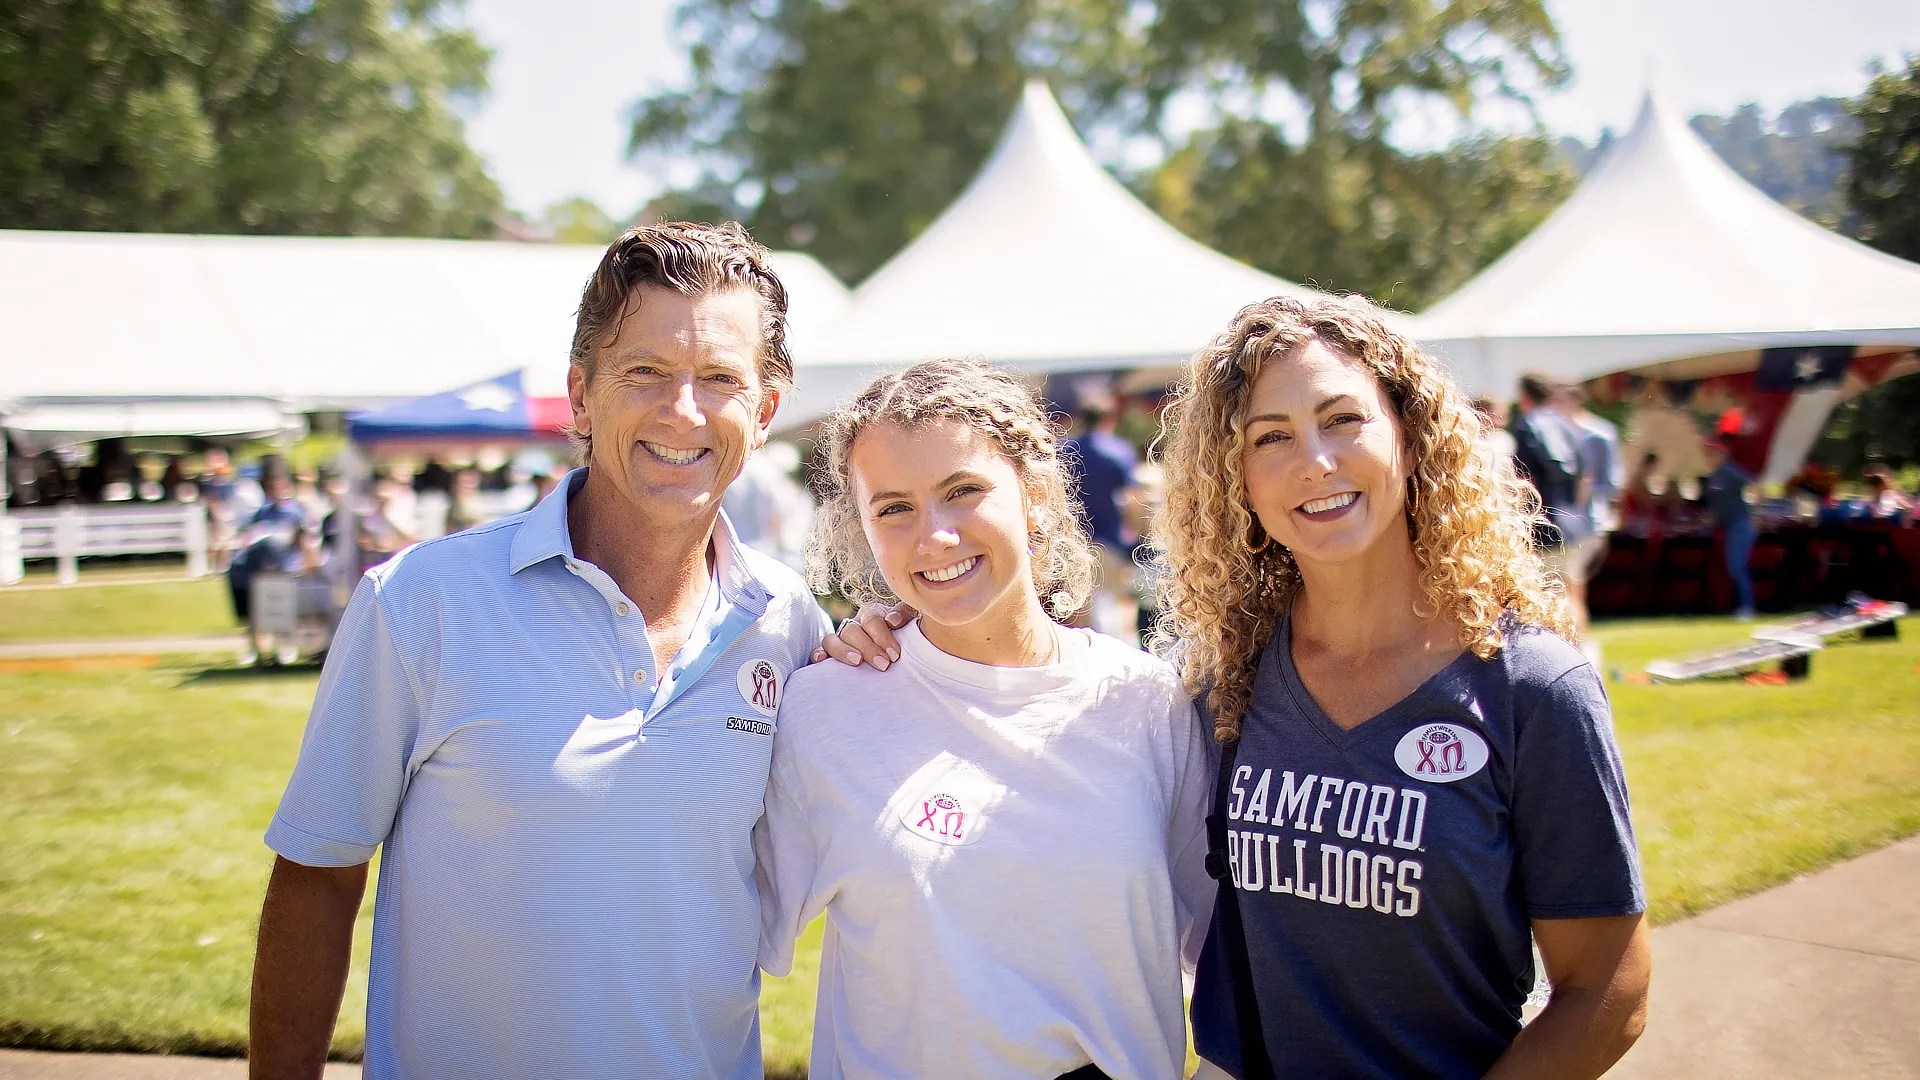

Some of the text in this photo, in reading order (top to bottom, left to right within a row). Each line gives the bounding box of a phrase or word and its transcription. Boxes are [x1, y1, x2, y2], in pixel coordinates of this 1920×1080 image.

[726, 717, 771, 735] SAMFORD
[1228, 765, 1427, 851] SAMFORD
[1228, 829, 1422, 917] BULLDOGS
